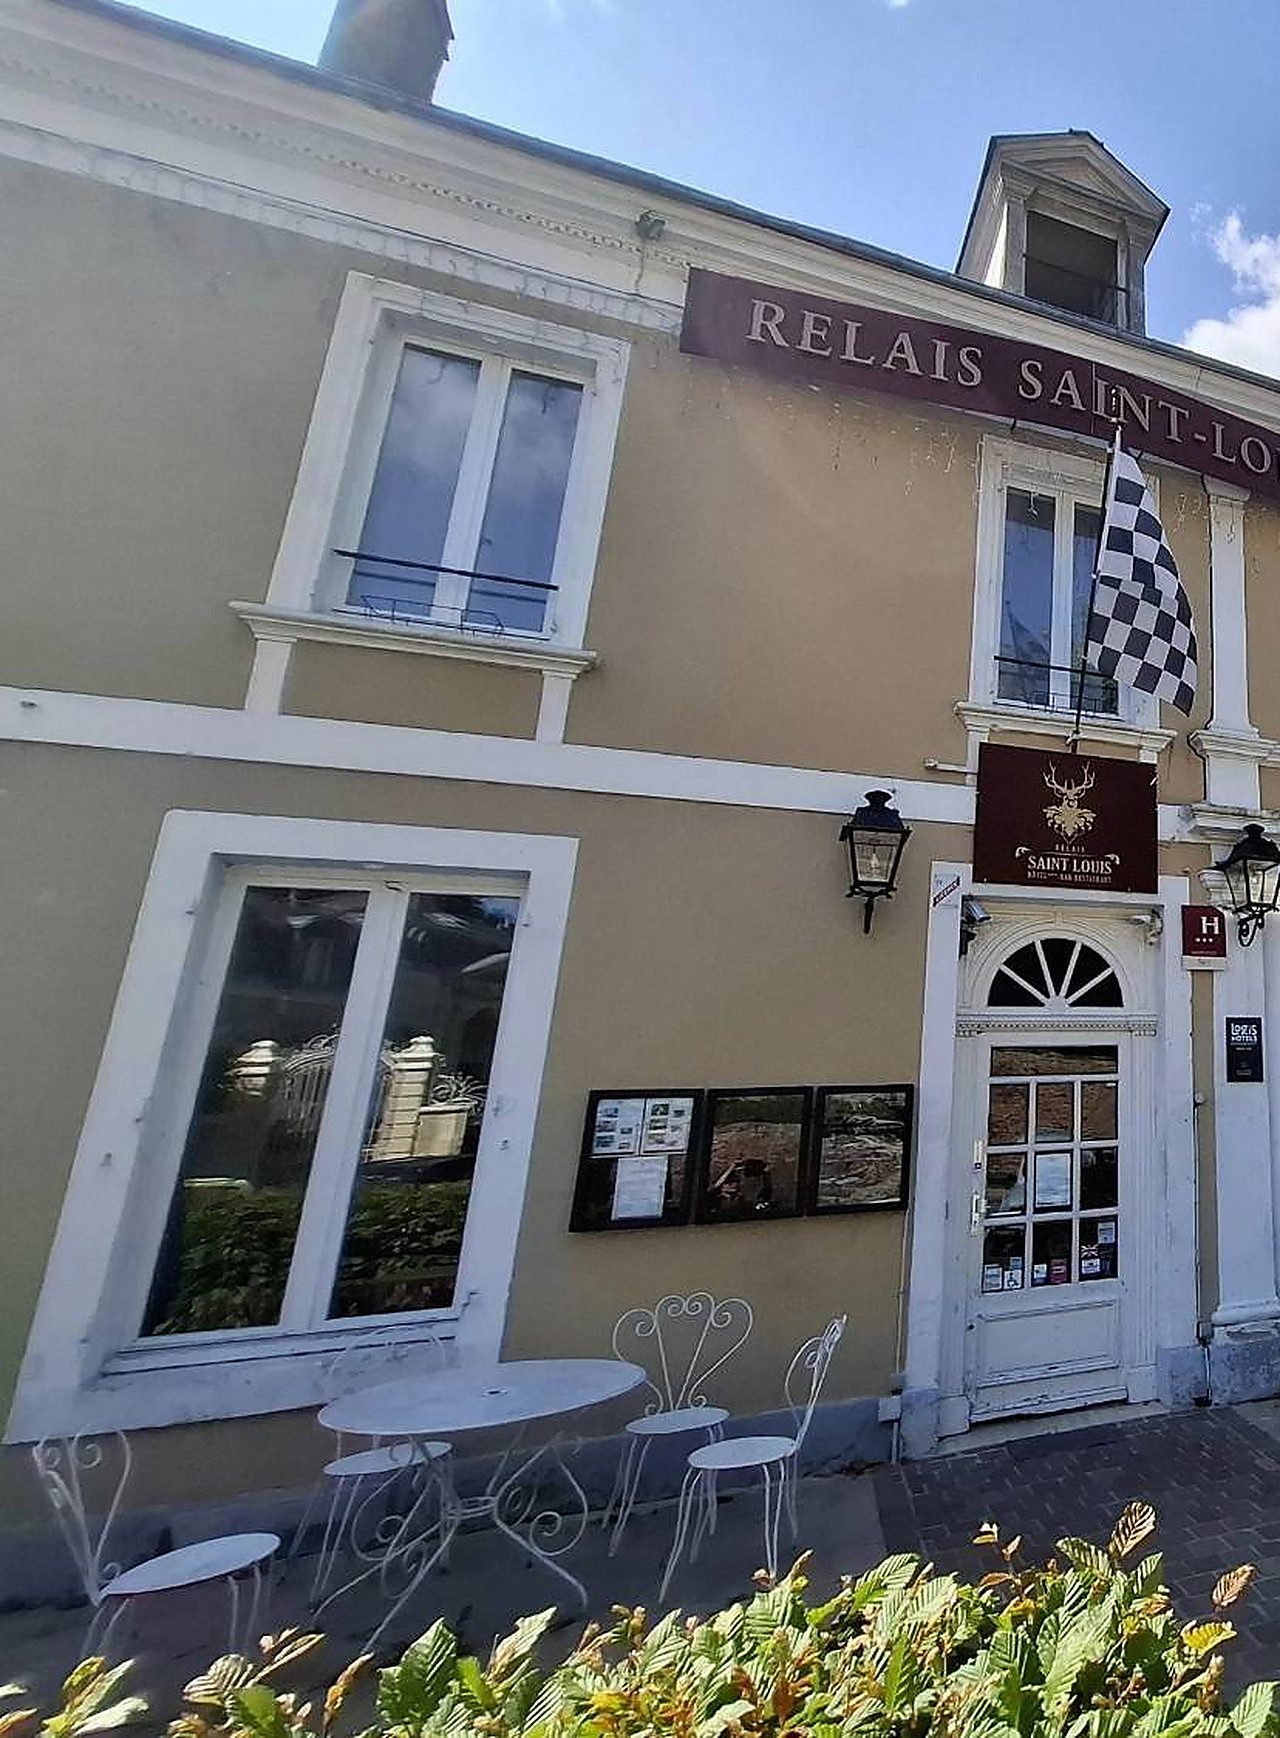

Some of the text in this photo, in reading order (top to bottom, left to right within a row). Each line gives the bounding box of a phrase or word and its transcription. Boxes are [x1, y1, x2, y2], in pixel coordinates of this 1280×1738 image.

[745, 299, 984, 387] RELAIS
[1027, 855, 1113, 874] SAINT LOUIS
[1201, 916, 1219, 935] H
[1231, 1035, 1258, 1043] HOTELS
